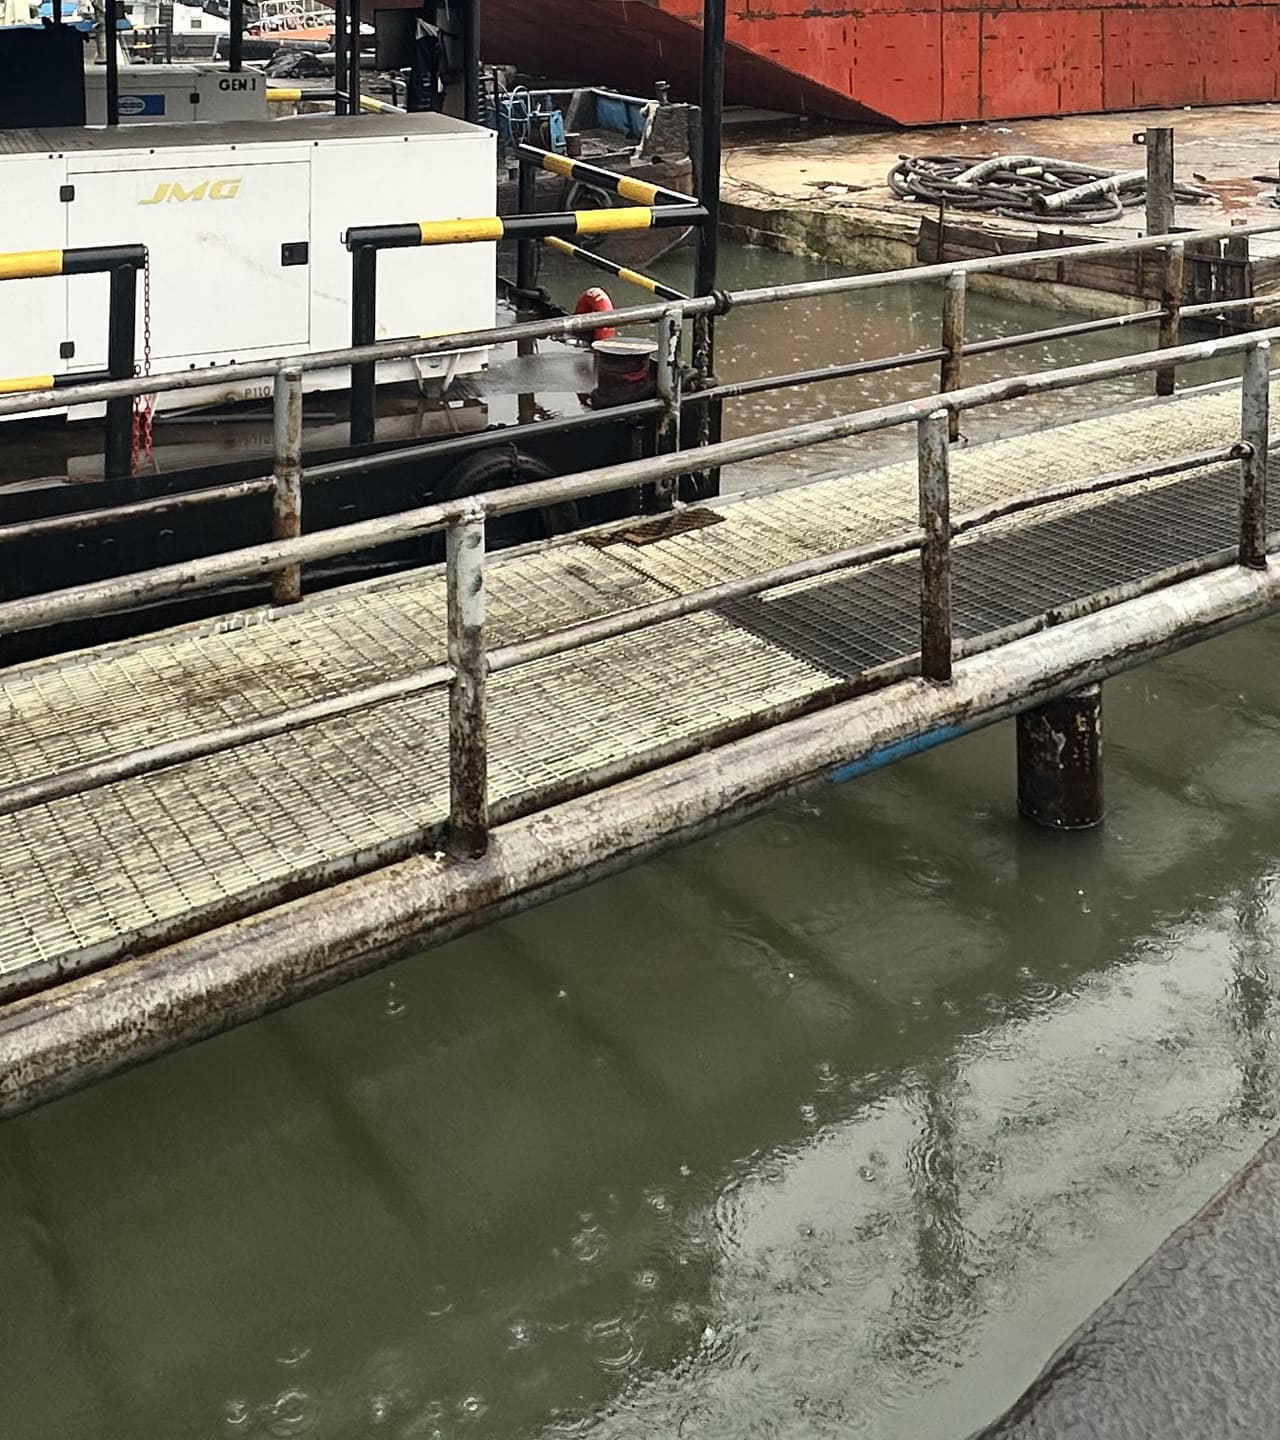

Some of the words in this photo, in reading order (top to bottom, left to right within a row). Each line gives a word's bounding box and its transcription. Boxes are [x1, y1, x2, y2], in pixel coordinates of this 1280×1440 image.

[219, 78, 248, 92] GEN
[250, 77, 257, 91] 1
[137, 178, 242, 206] JMG
